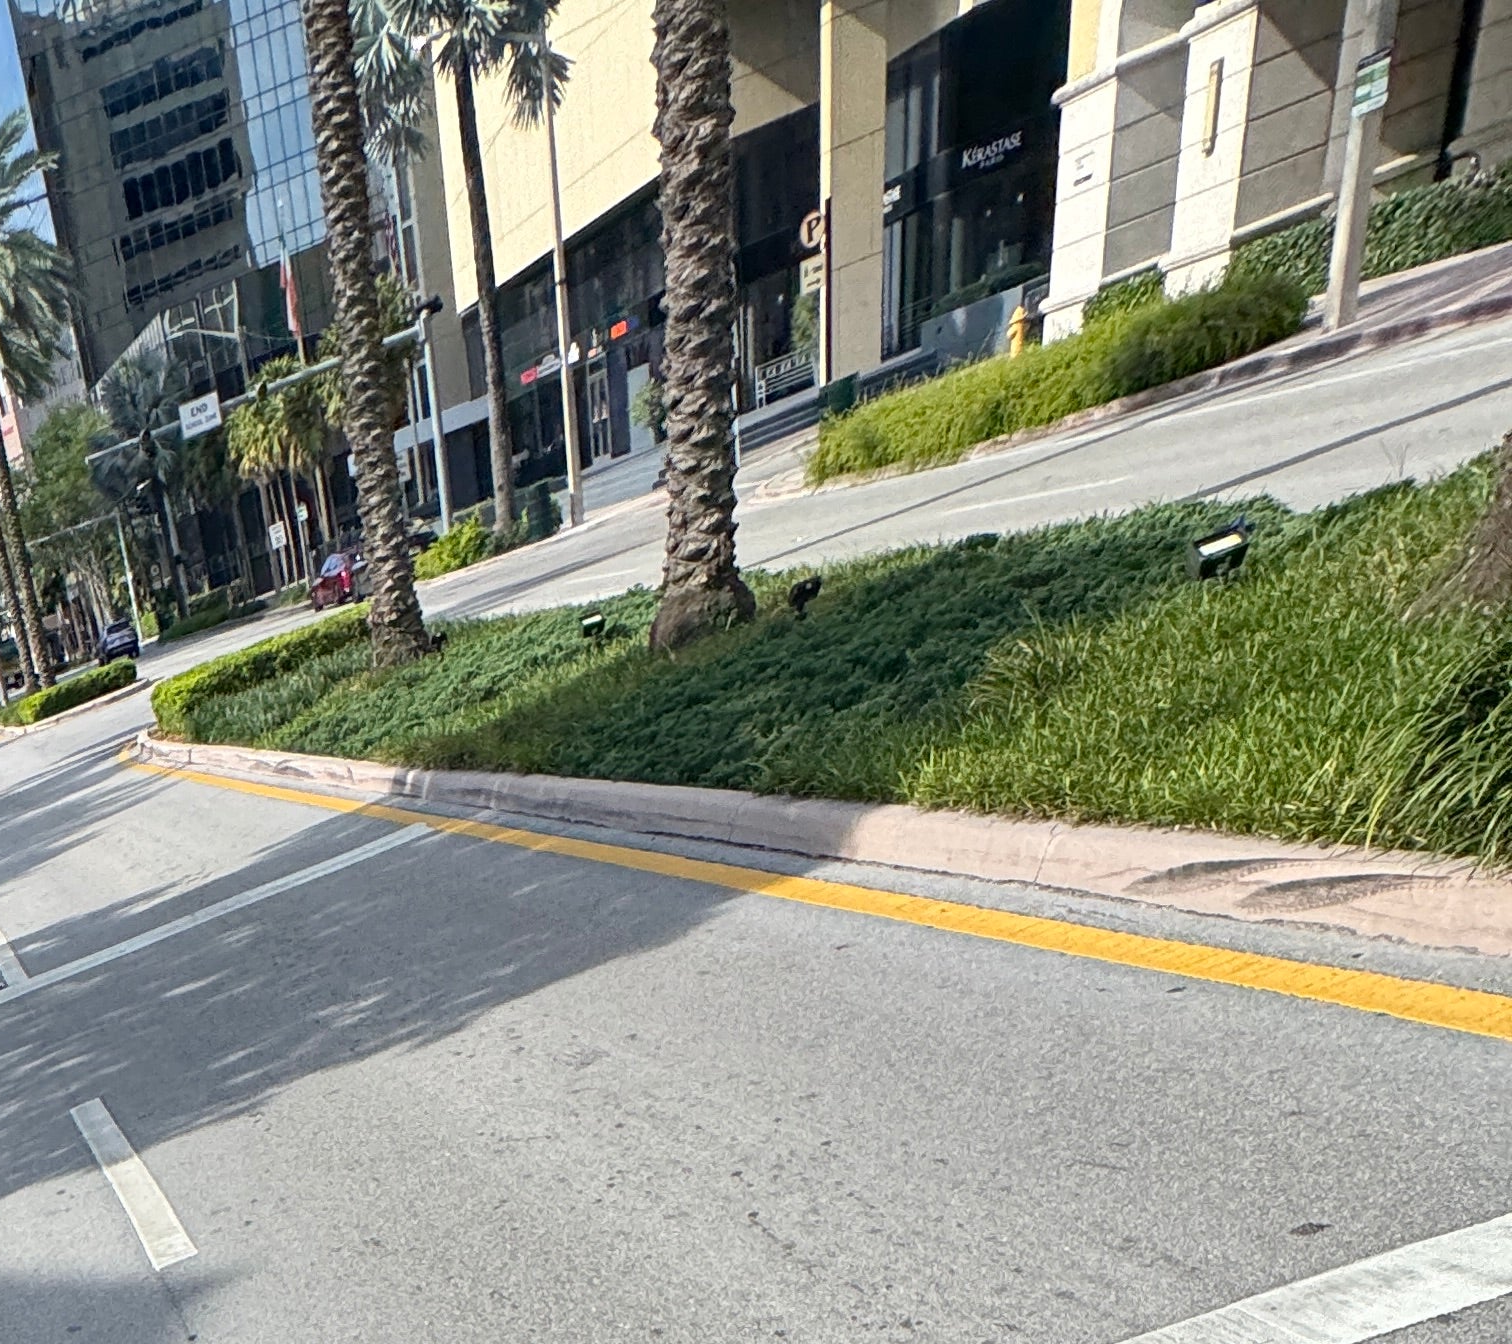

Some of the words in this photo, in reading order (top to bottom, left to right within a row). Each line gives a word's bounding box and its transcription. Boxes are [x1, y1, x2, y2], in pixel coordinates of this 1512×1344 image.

[961, 130, 1023, 169] KÉRASTASE
[806, 215, 822, 244] P
[190, 402, 208, 417] END
